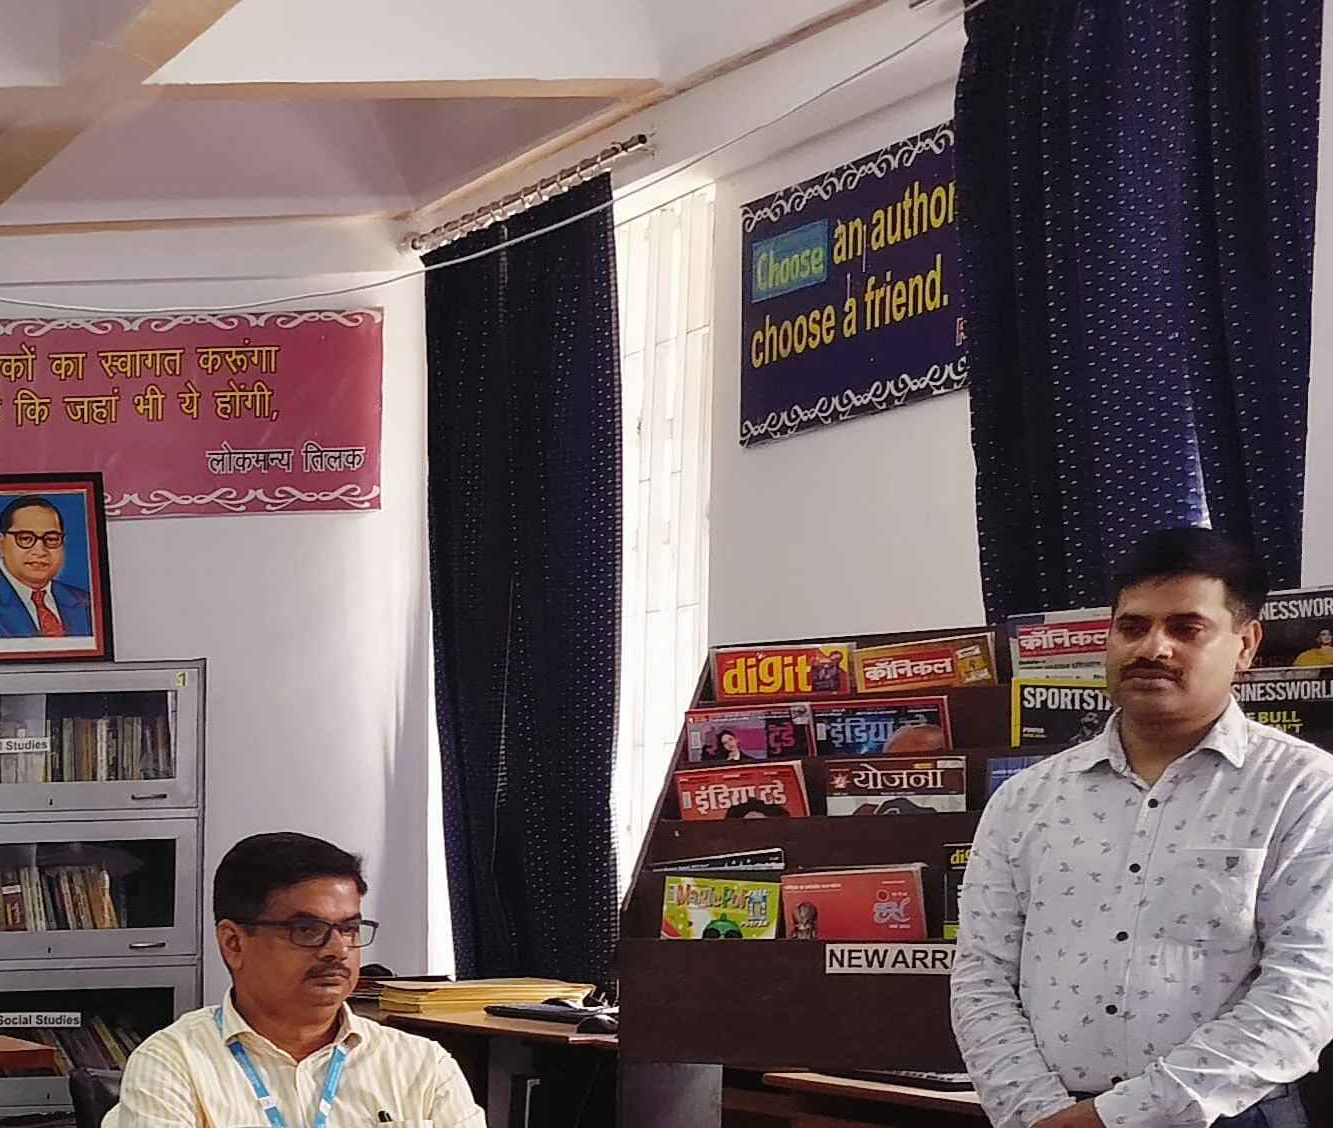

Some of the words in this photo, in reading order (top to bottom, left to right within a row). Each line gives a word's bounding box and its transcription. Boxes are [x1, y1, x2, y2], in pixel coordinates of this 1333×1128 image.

[755, 243, 824, 291] Choose
[831, 217, 865, 263] an
[751, 303, 836, 369] choose
[841, 292, 858, 337] a
[863, 254, 949, 332] friend.
[50, 351, 88, 380] का
[99, 348, 184, 378] स्वागत
[14, 389, 50, 427] कि
[132, 381, 166, 421] भी
[179, 382, 200, 418] ये
[302, 441, 364, 472] तिलक
[722, 656, 813, 694] digit
[1259, 711, 1301, 723] BULL
[5, 740, 48, 751] Studies
[852, 763, 945, 790] योजना
[829, 949, 891, 969] NEW
[35, 1014, 80, 1025] Studies
